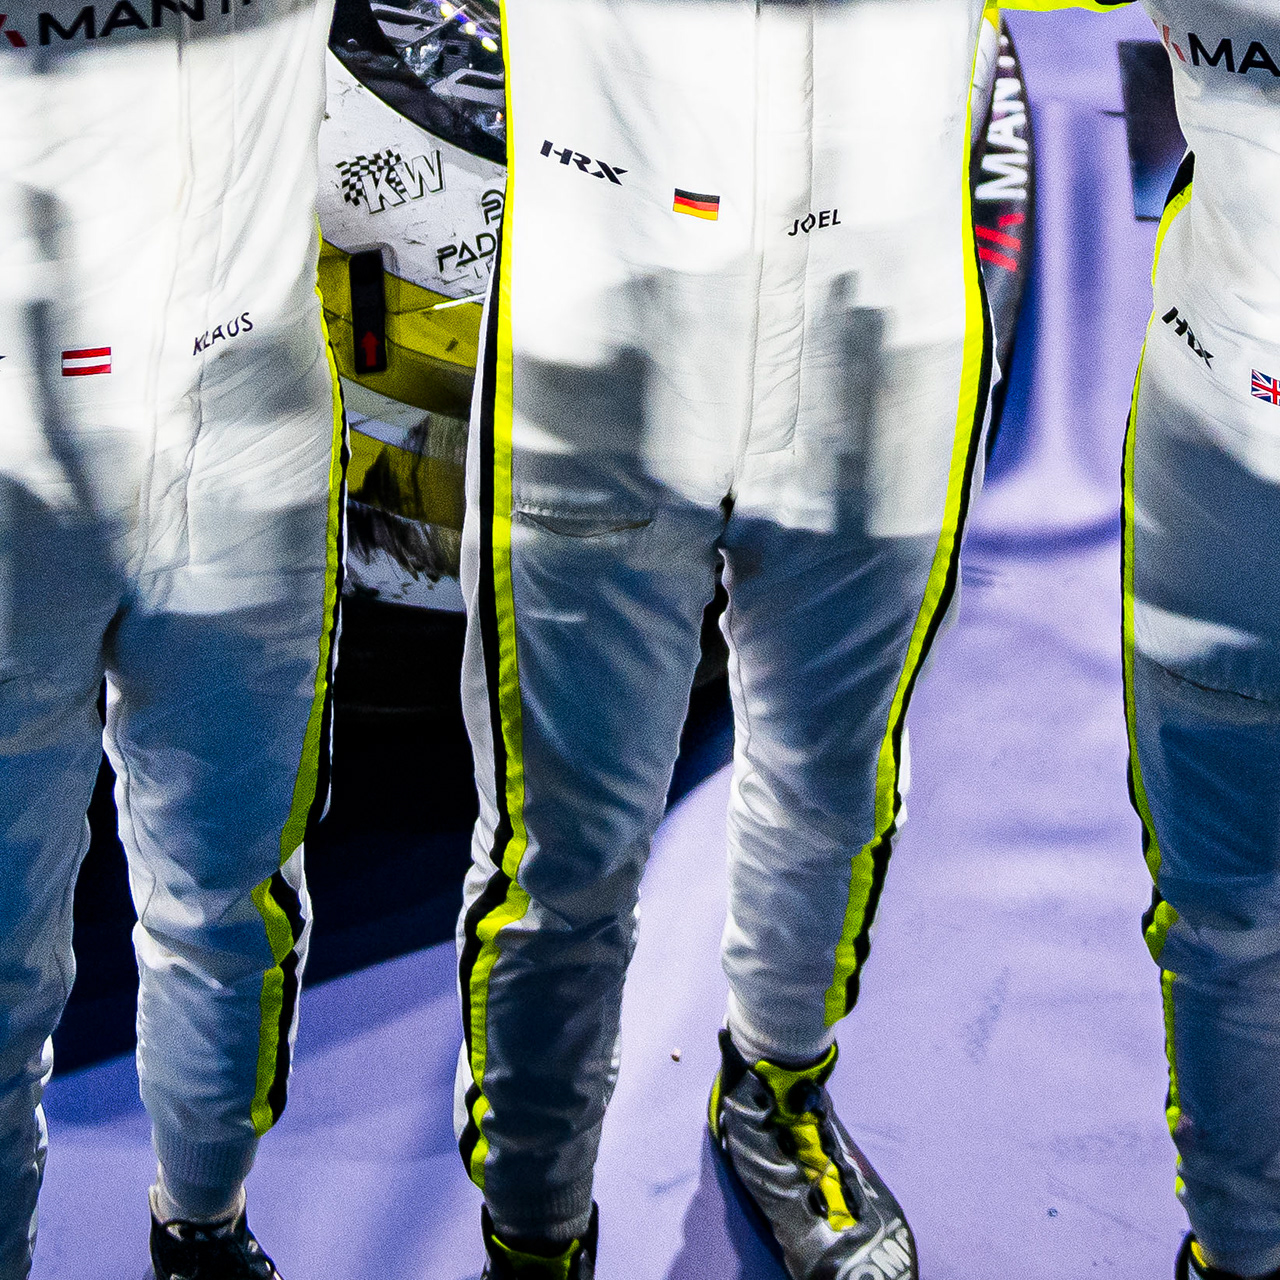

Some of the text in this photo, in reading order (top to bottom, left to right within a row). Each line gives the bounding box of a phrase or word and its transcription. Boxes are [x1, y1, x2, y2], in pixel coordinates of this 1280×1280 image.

[362, 150, 445, 214] KW
[540, 140, 628, 186] HRX
[787, 209, 841, 237] JOEL
[192, 312, 254, 356] KLAUS
